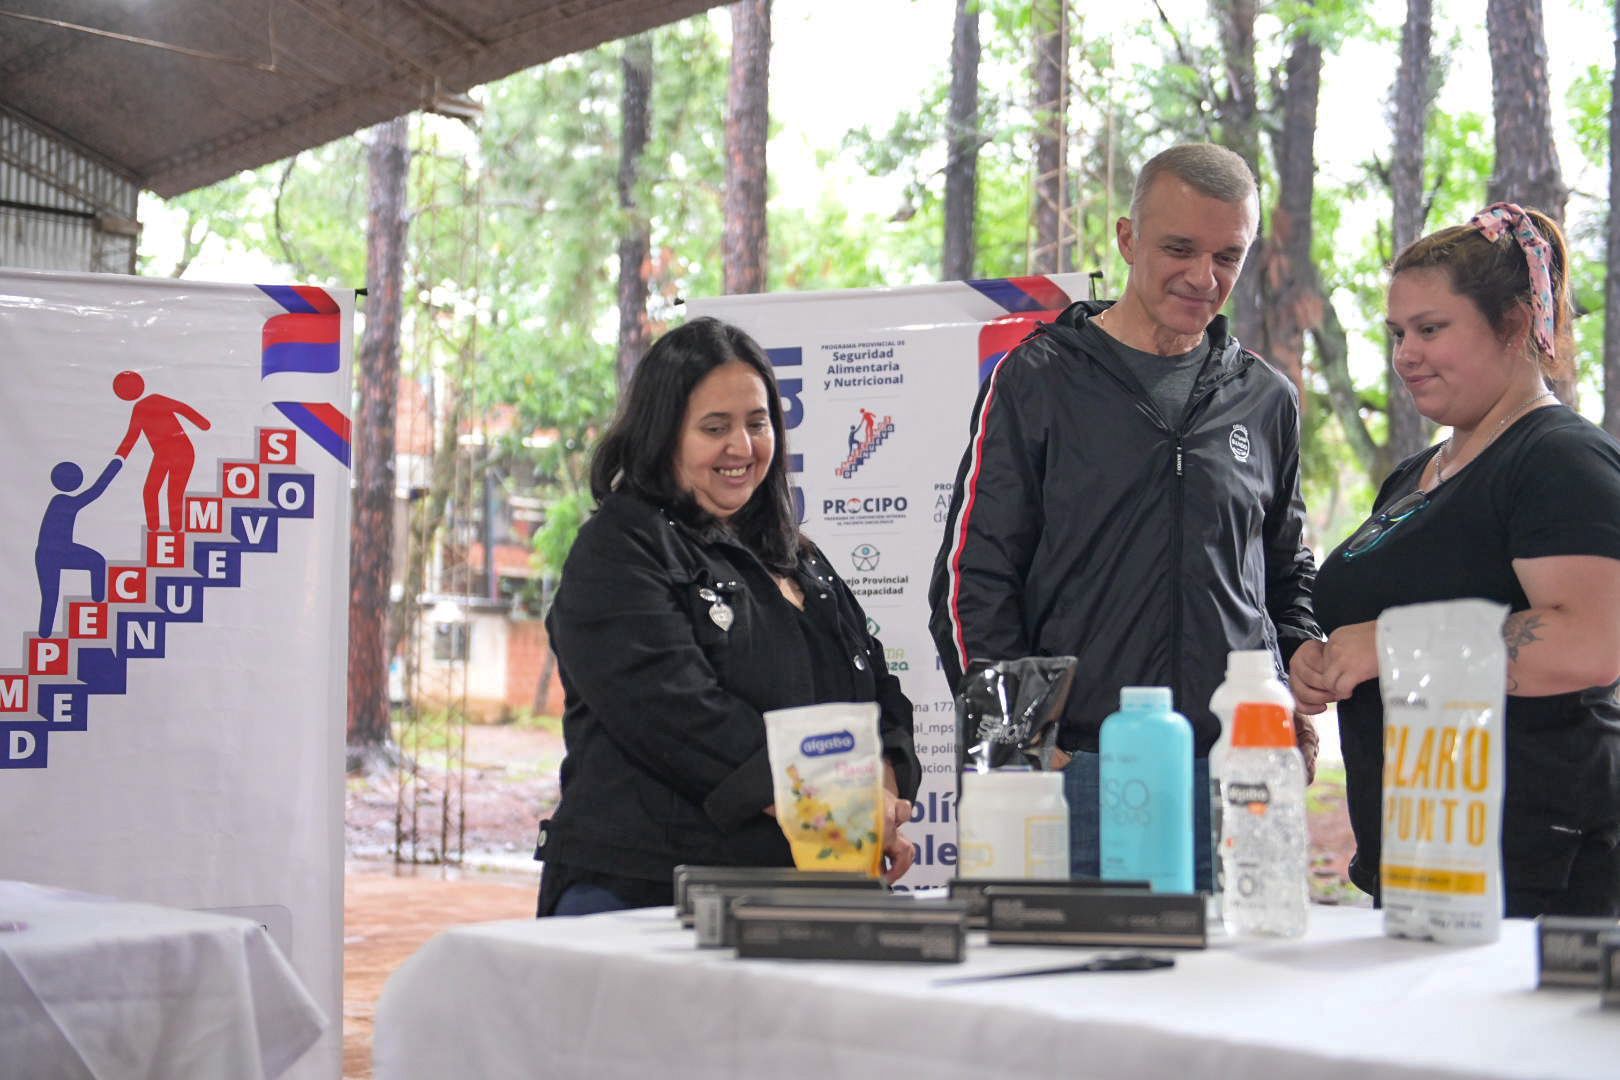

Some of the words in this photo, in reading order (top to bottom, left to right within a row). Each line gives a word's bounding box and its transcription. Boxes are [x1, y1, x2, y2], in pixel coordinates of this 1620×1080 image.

[832, 348, 894, 363] Seguridad
[827, 361, 900, 374] Alimentaria
[824, 380, 831, 391] y
[834, 374, 904, 387] Nutricional
[823, 496, 908, 514] PROCIPO
[862, 575, 909, 585] Provincial
